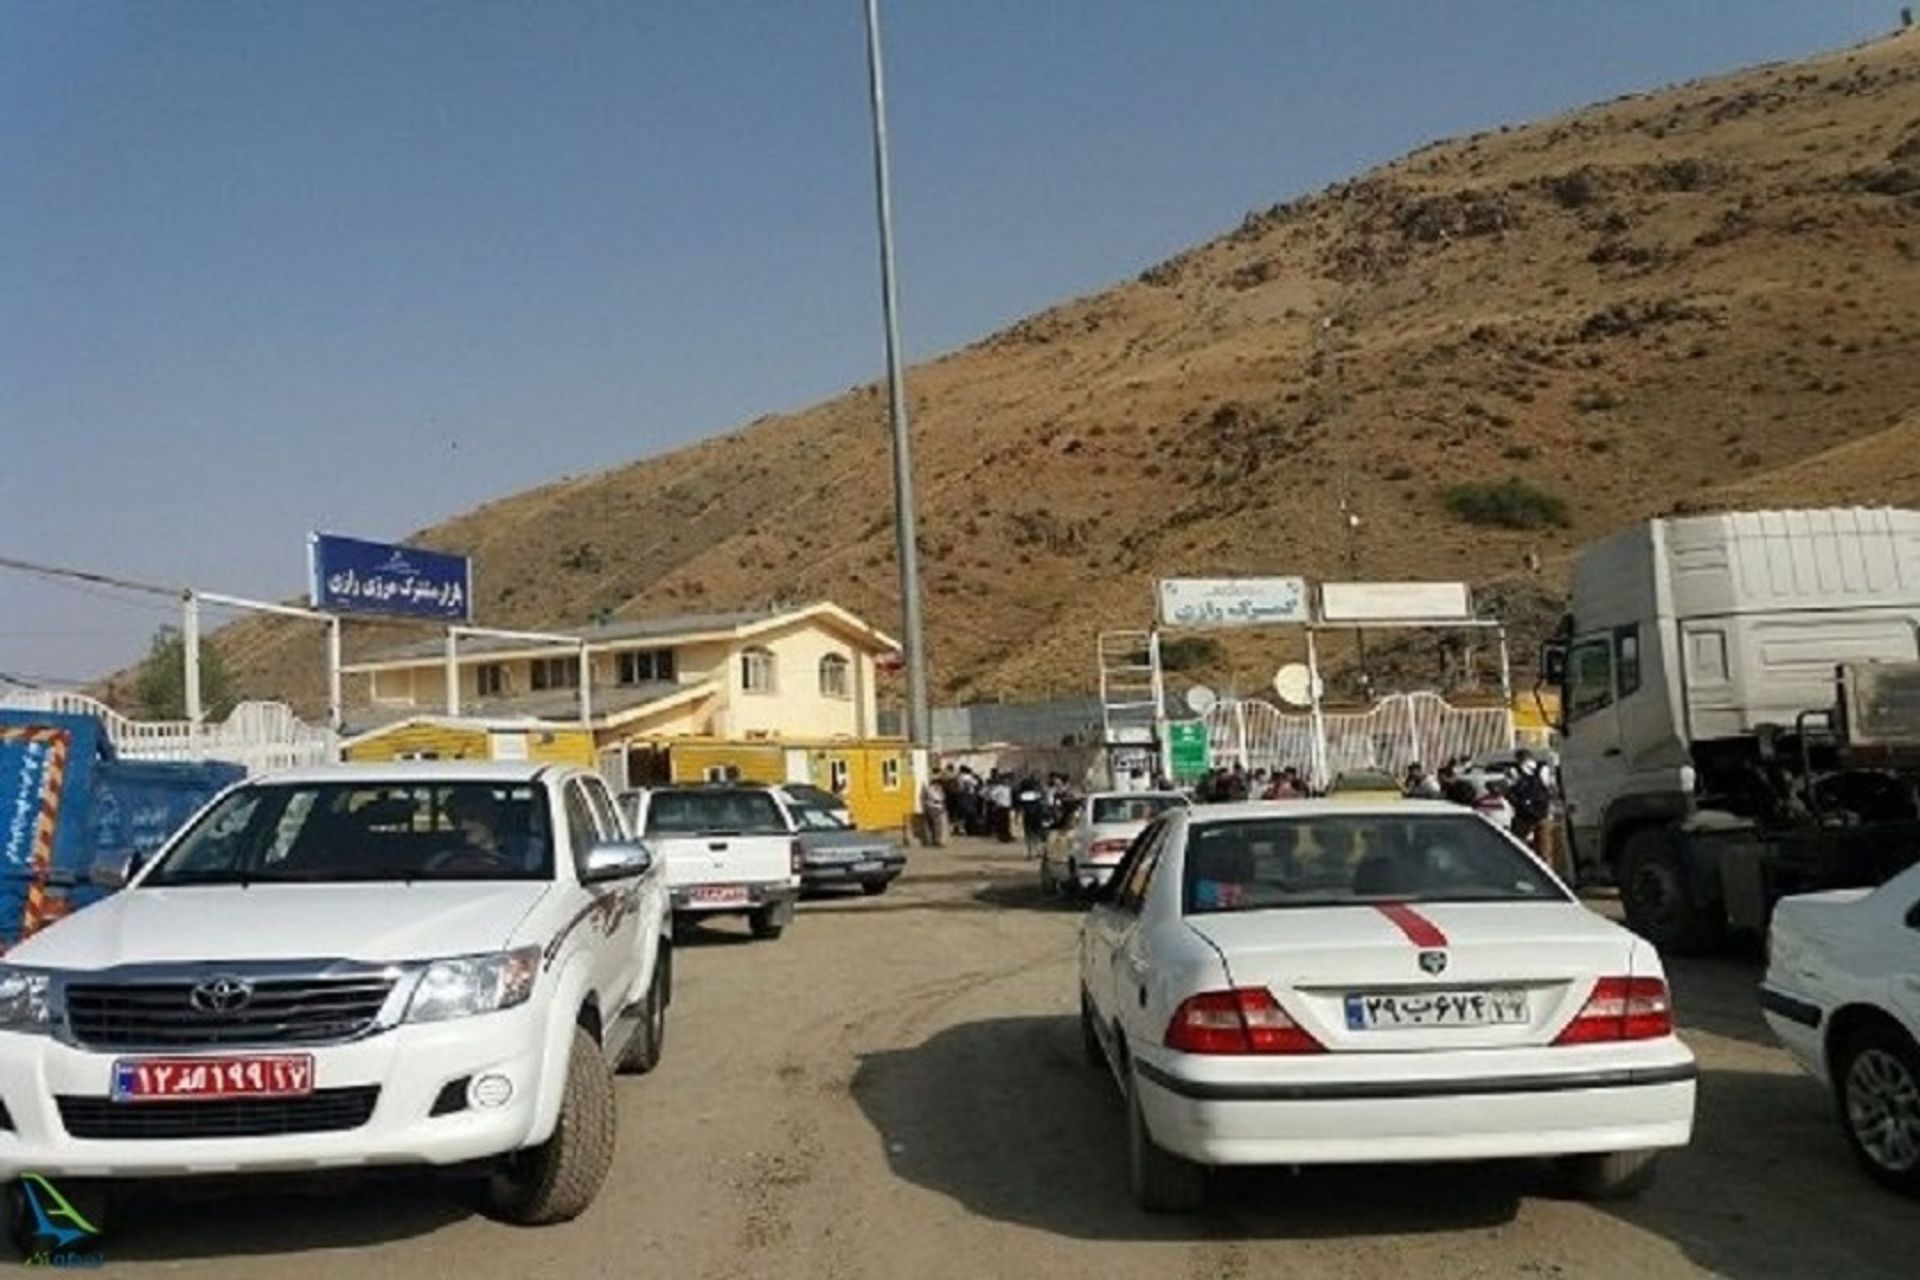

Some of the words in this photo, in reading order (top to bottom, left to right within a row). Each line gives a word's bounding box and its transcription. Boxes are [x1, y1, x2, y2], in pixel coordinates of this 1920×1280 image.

[328, 568, 360, 597] رازی
[363, 575, 398, 599] مرزی
[400, 576, 438, 602] مشترک
